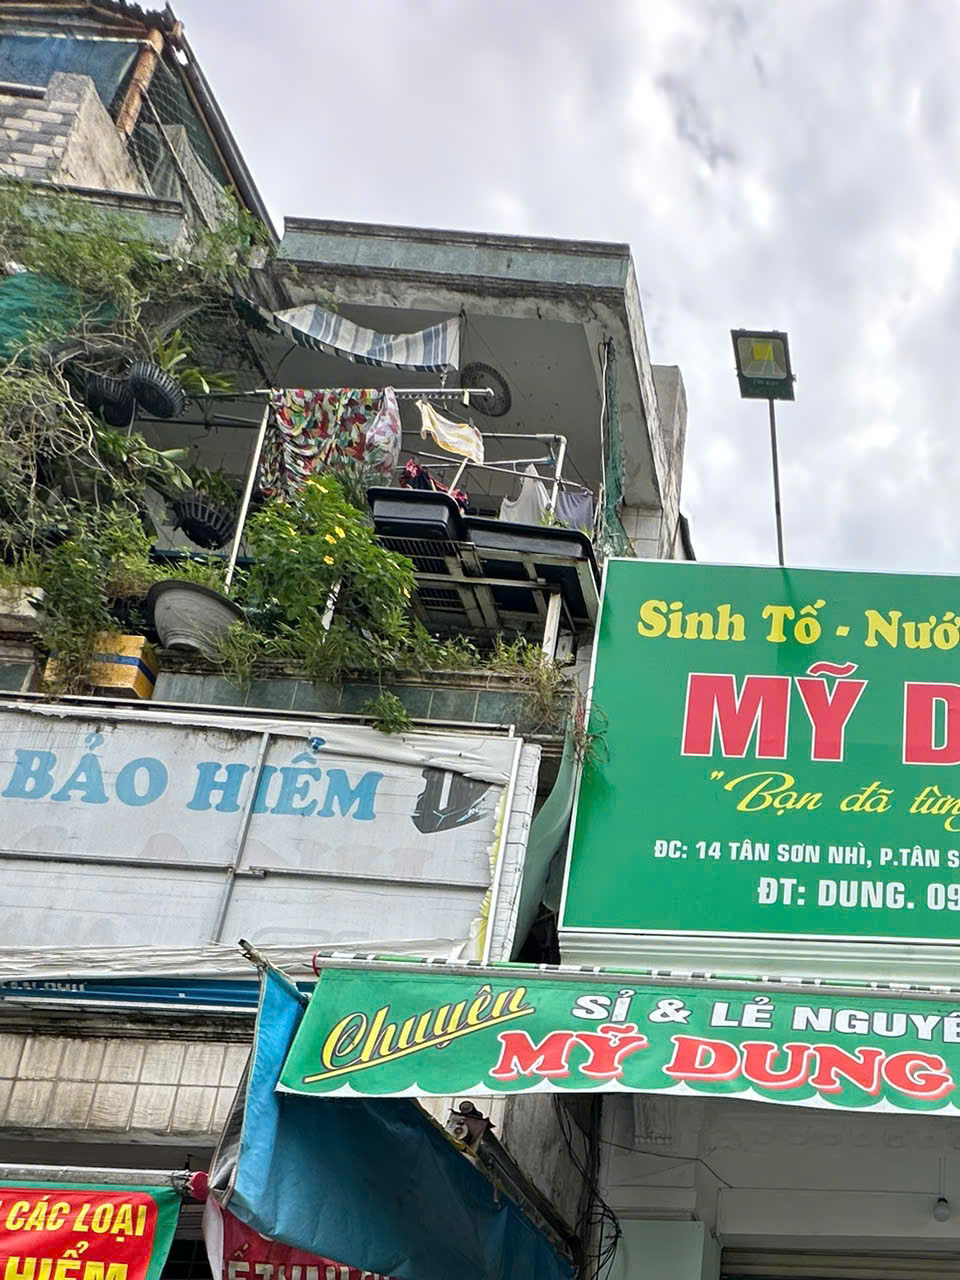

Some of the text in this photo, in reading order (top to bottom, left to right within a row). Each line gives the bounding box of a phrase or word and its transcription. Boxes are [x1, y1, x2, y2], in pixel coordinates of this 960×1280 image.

[637, 599, 746, 642] Sinh
[761, 599, 826, 644] Tố
[680, 660, 869, 763] MỸ
[1, 732, 385, 821] BẢO HIỂM
[840, 781, 895, 813] đã
[654, 839, 688, 859] ĐC:
[695, 841, 721, 860] 14
[729, 839, 770, 862] TÂN
[777, 842, 820, 864] SƠN
[828, 842, 873, 869] NHÌ,
[879, 845, 940, 868] P.TÂN
[757, 877, 806, 906] ĐT:
[818, 879, 915, 910] DUNG.
[321, 984, 527, 1071] Chuyên
[571, 989, 637, 1023] SỈ
[647, 997, 693, 1025] &
[710, 996, 776, 1030] LẺ
[488, 1024, 956, 1100] MỸ DUNG
[5, 1195, 147, 1242] CÁC LOẠI
